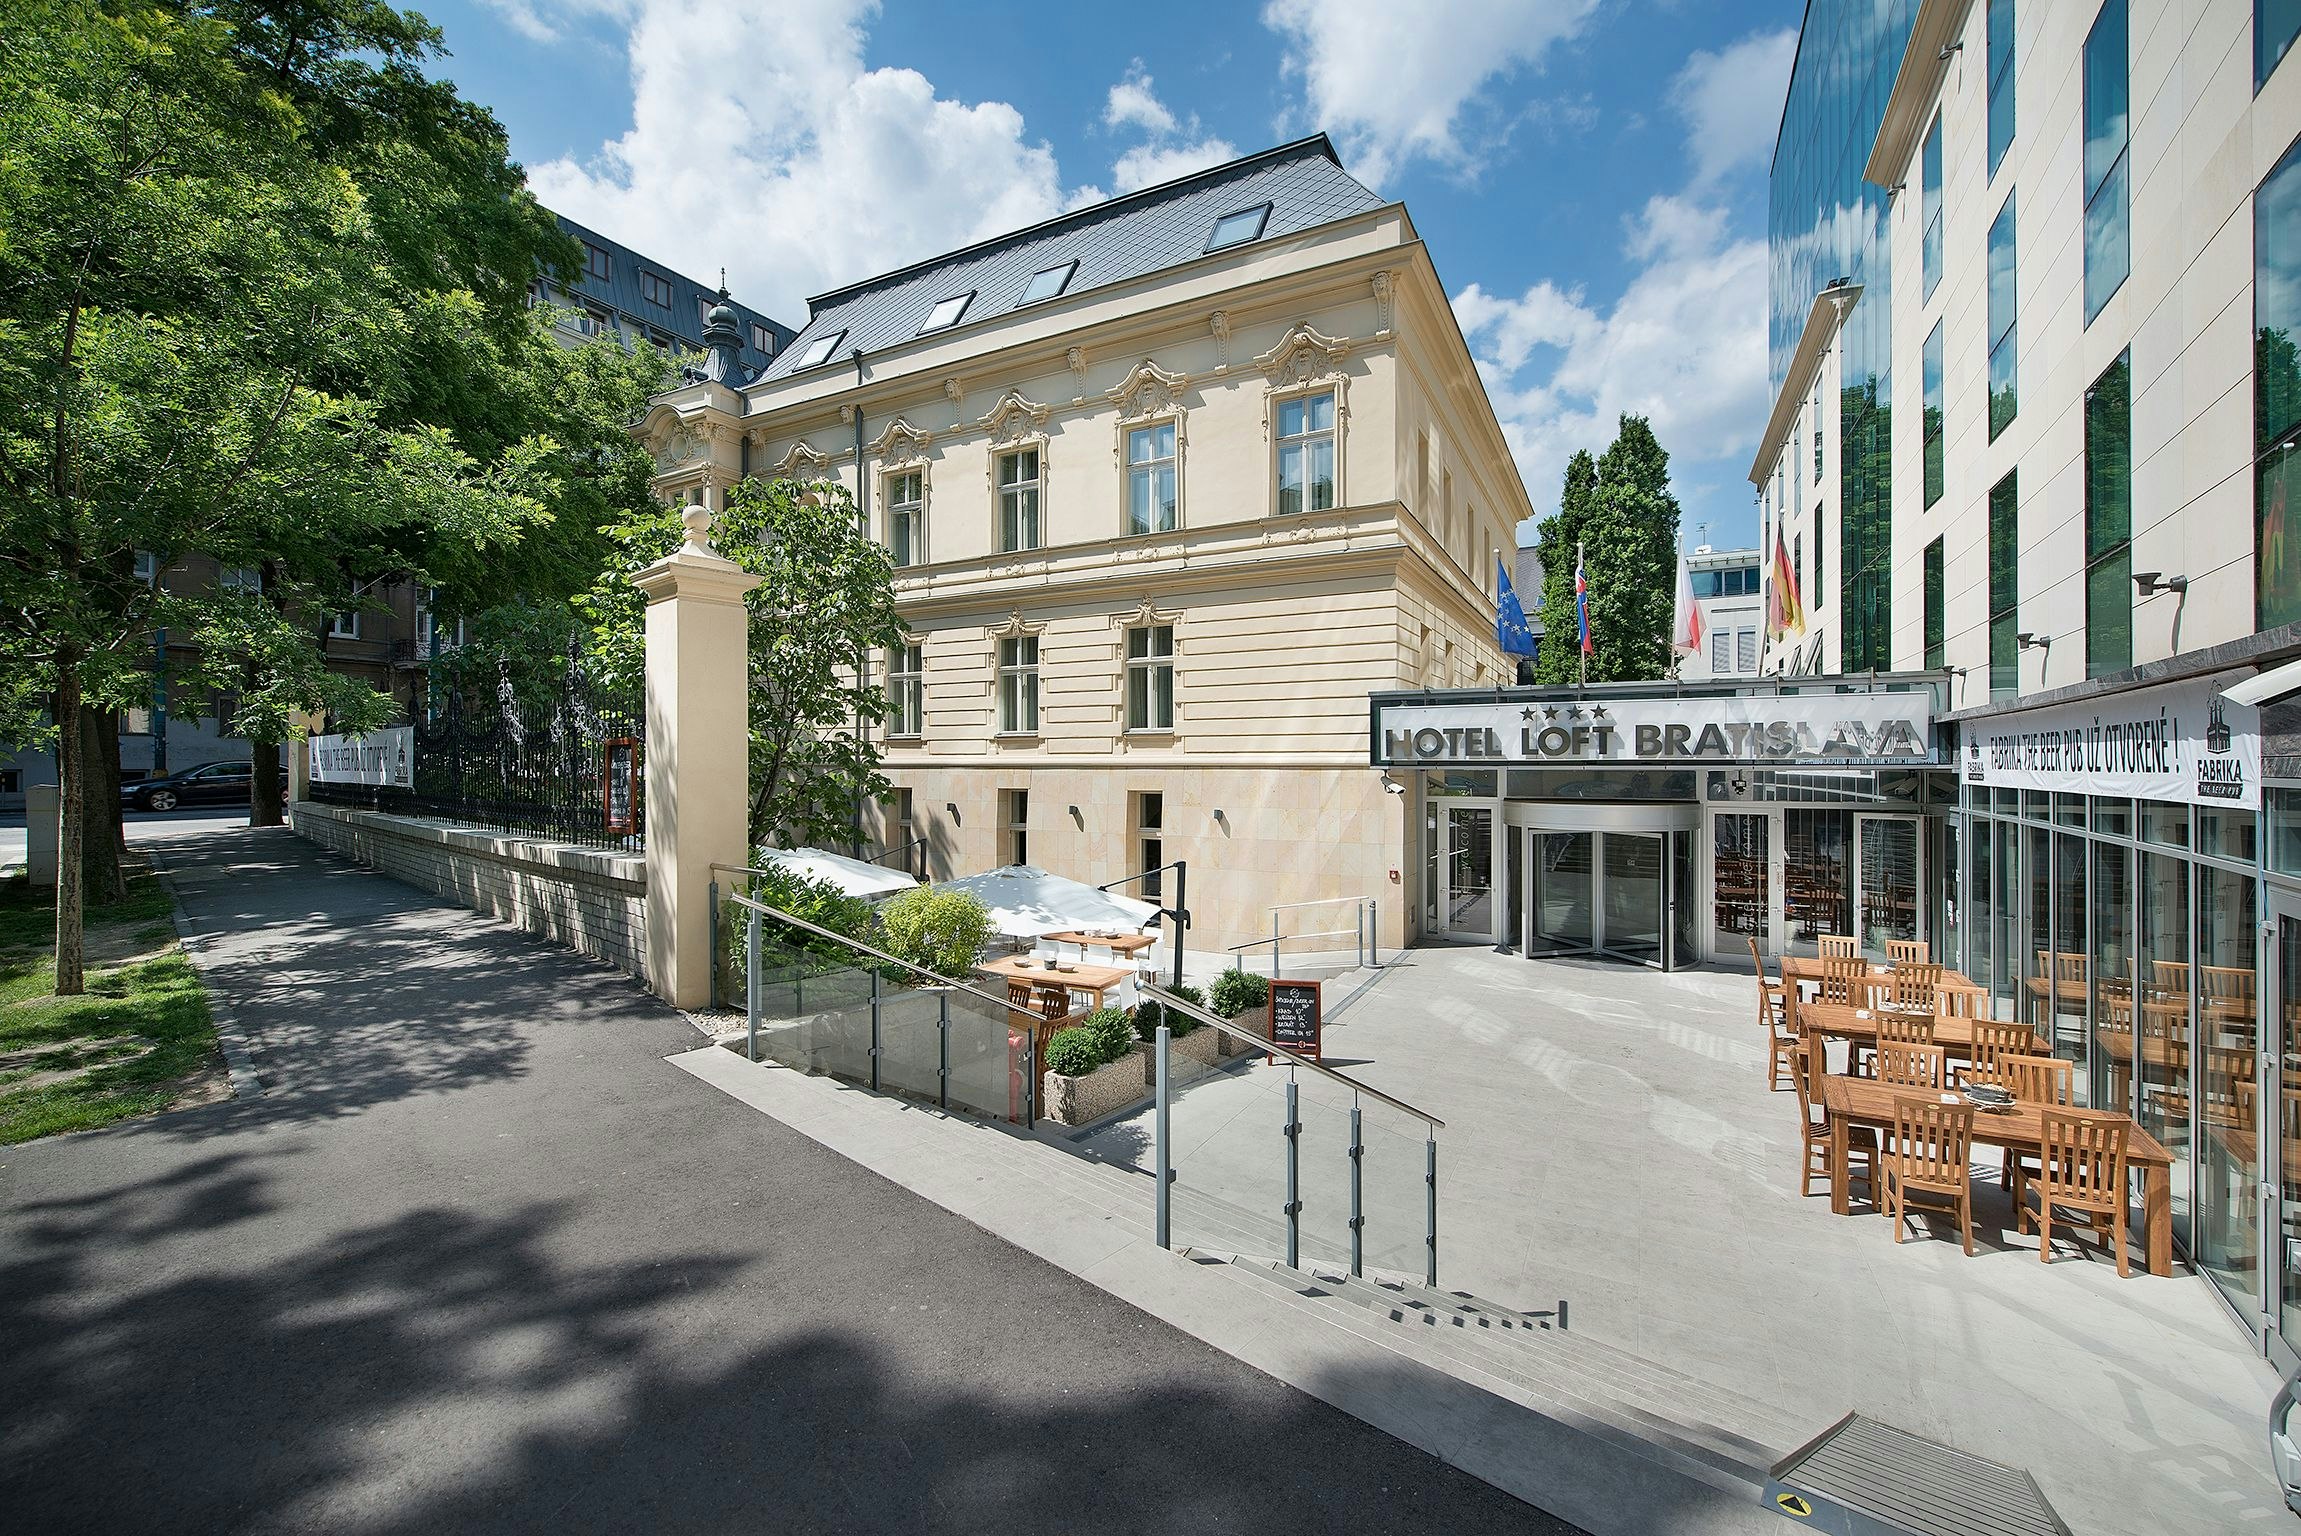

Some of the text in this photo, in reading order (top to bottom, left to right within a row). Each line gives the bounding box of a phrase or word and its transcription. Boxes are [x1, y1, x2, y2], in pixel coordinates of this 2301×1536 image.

[1386, 720, 1927, 758] HOTEL LOFT BRATISLAVA
[1990, 734, 2021, 770] FABRIKA
[2022, 733, 2038, 771] THE
[2040, 731, 2061, 771] BEER
[2063, 728, 2083, 772] PUB
[2086, 716, 2101, 772] UŽ
[2104, 706, 2170, 773] OTVORENÉ
[2198, 760, 2242, 782] FABRIKA
[1459, 811, 1470, 870] welcome
[1740, 818, 1753, 885] welcome
